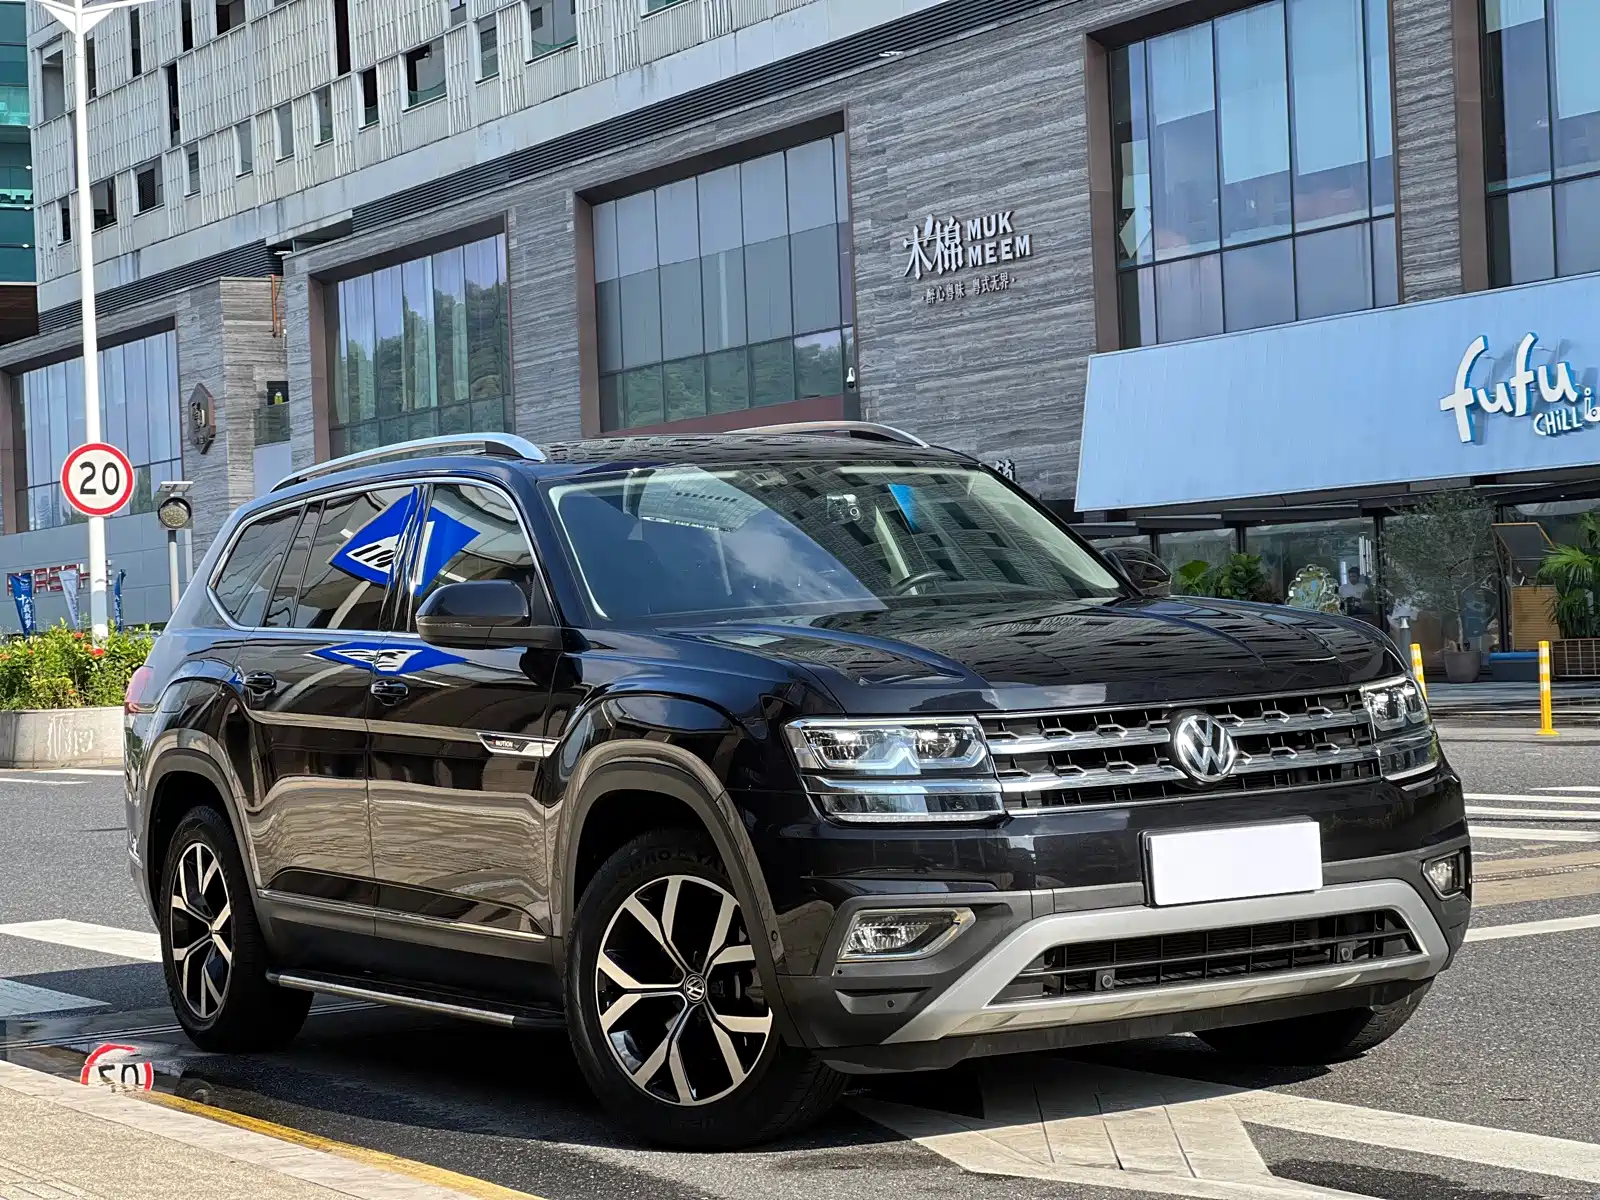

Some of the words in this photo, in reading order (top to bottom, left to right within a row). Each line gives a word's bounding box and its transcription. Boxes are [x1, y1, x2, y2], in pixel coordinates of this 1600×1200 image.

[967, 211, 1013, 241] MUK
[903, 214, 964, 279] 木棉
[968, 234, 1031, 267] MEEM
[1440, 332, 1579, 442] fufu
[79, 461, 120, 496] 20
